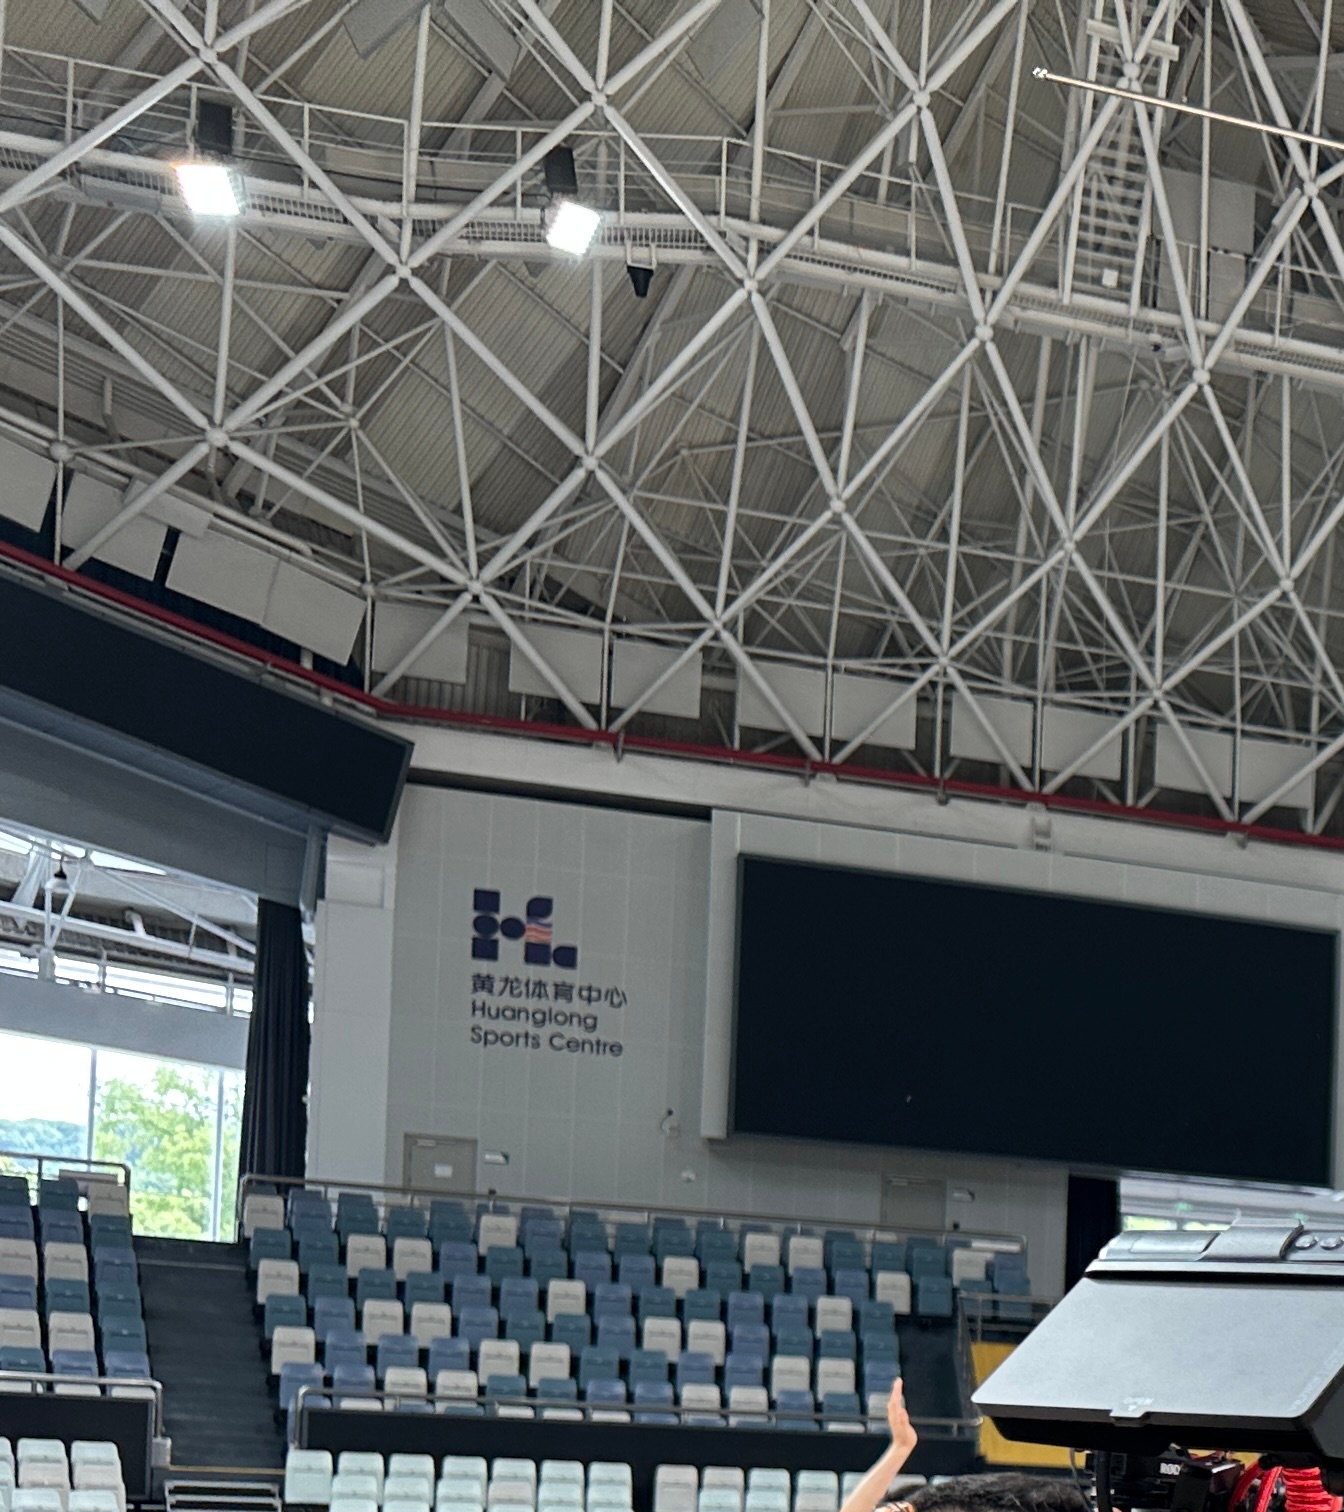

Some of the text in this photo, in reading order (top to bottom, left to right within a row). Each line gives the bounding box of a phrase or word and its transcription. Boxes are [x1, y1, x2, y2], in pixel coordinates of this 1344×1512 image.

[470, 972, 628, 1009] 黄龙体育中心
[470, 1001, 598, 1033] Huanglong
[470, 1024, 623, 1057] Sports Centre
